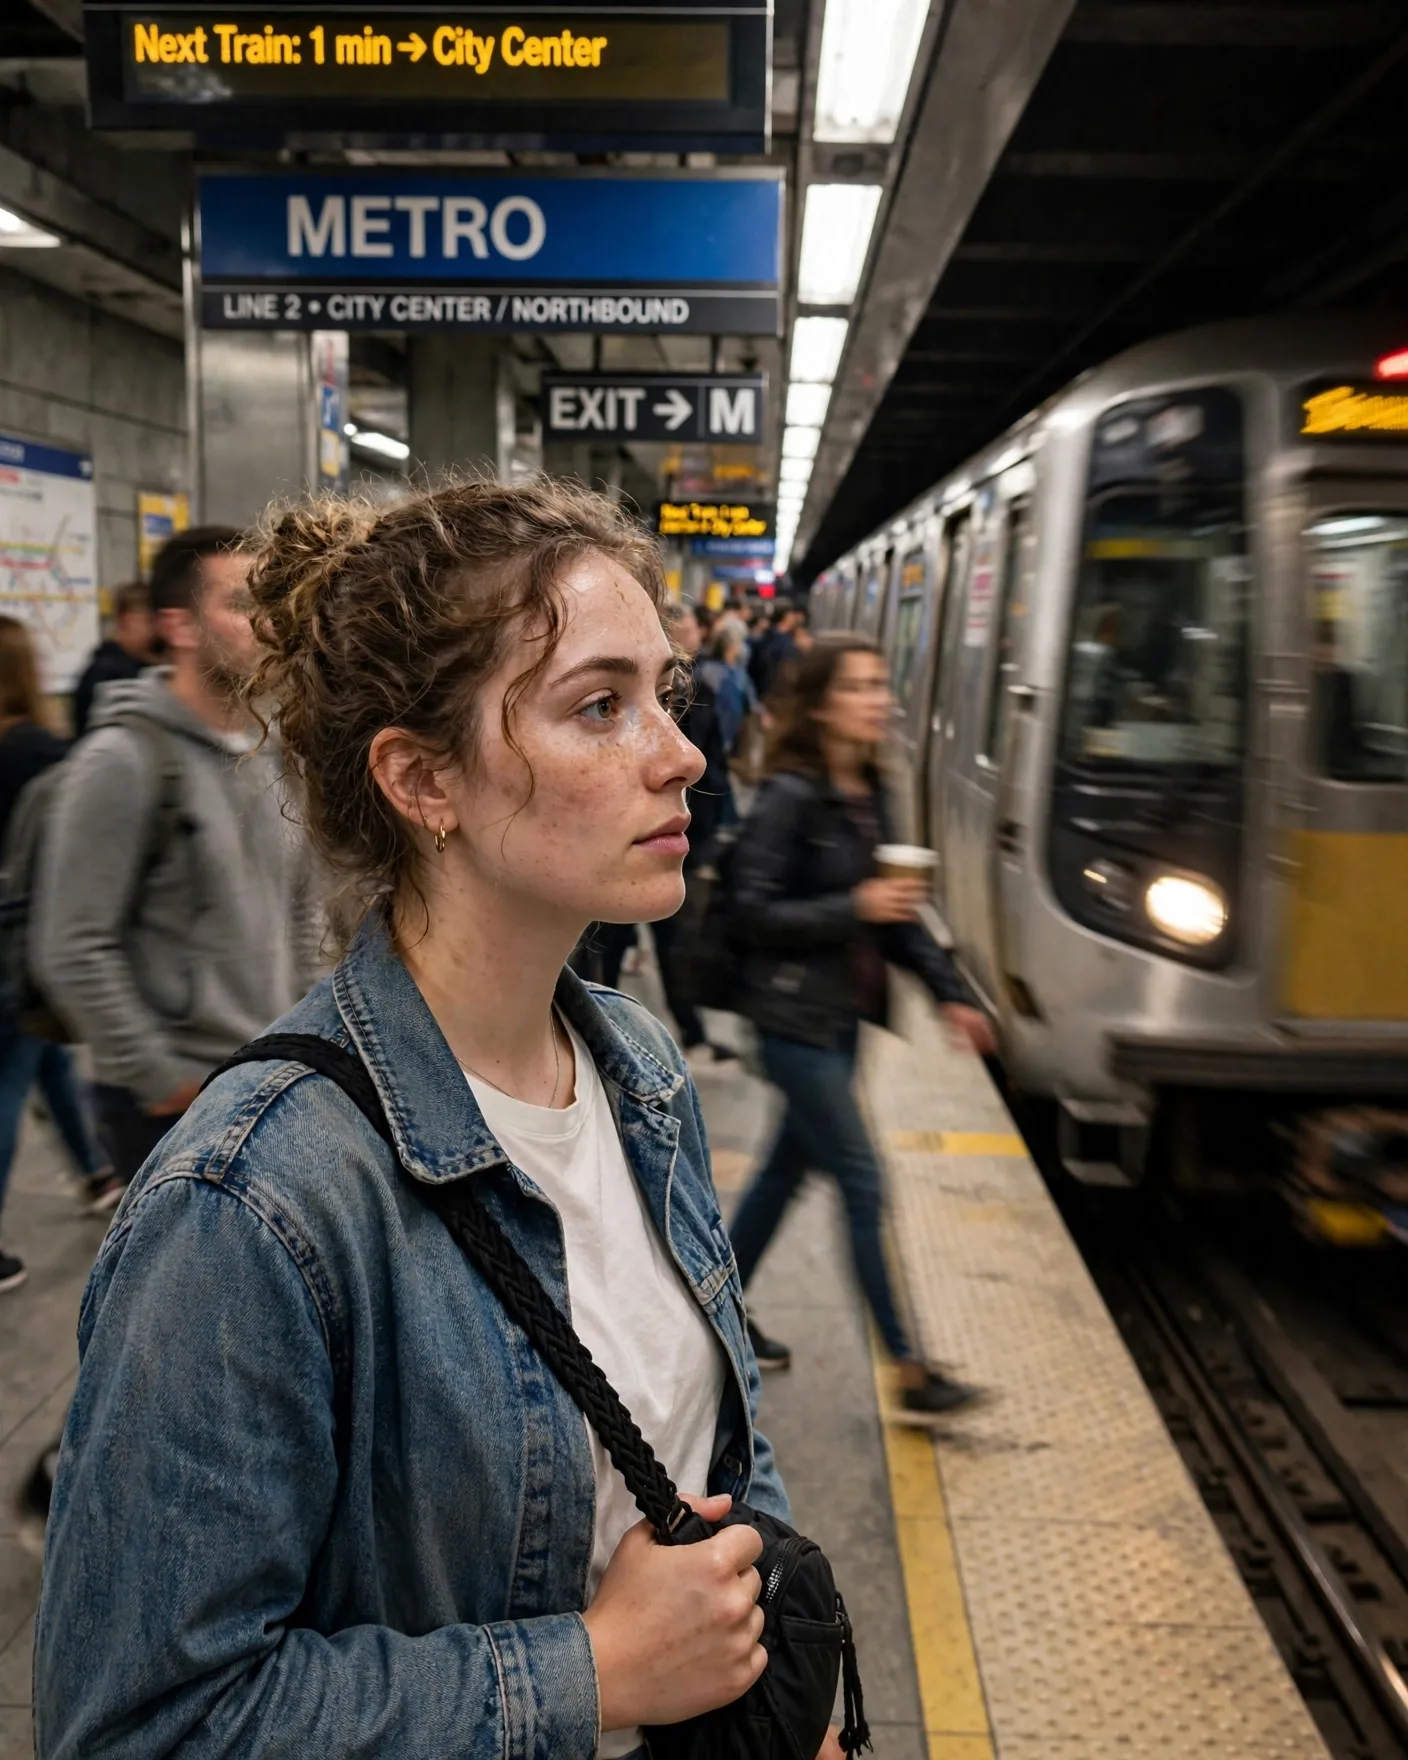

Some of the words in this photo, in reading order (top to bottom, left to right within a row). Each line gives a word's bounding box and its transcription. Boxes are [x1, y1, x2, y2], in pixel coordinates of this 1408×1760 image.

[134, 23, 209, 63] Next
[213, 24, 302, 65] Train:
[309, 25, 325, 65] 1
[335, 25, 392, 65] min
[432, 25, 495, 75] City
[501, 26, 608, 67] Center
[287, 195, 546, 261] METRO
[223, 293, 279, 320] LINE
[284, 293, 302, 320] 2
[326, 294, 385, 321] CITY
[389, 295, 492, 322] CENTER
[512, 296, 690, 324] NORTHBOUND
[550, 386, 647, 431] EXIT
[709, 387, 755, 434] M
